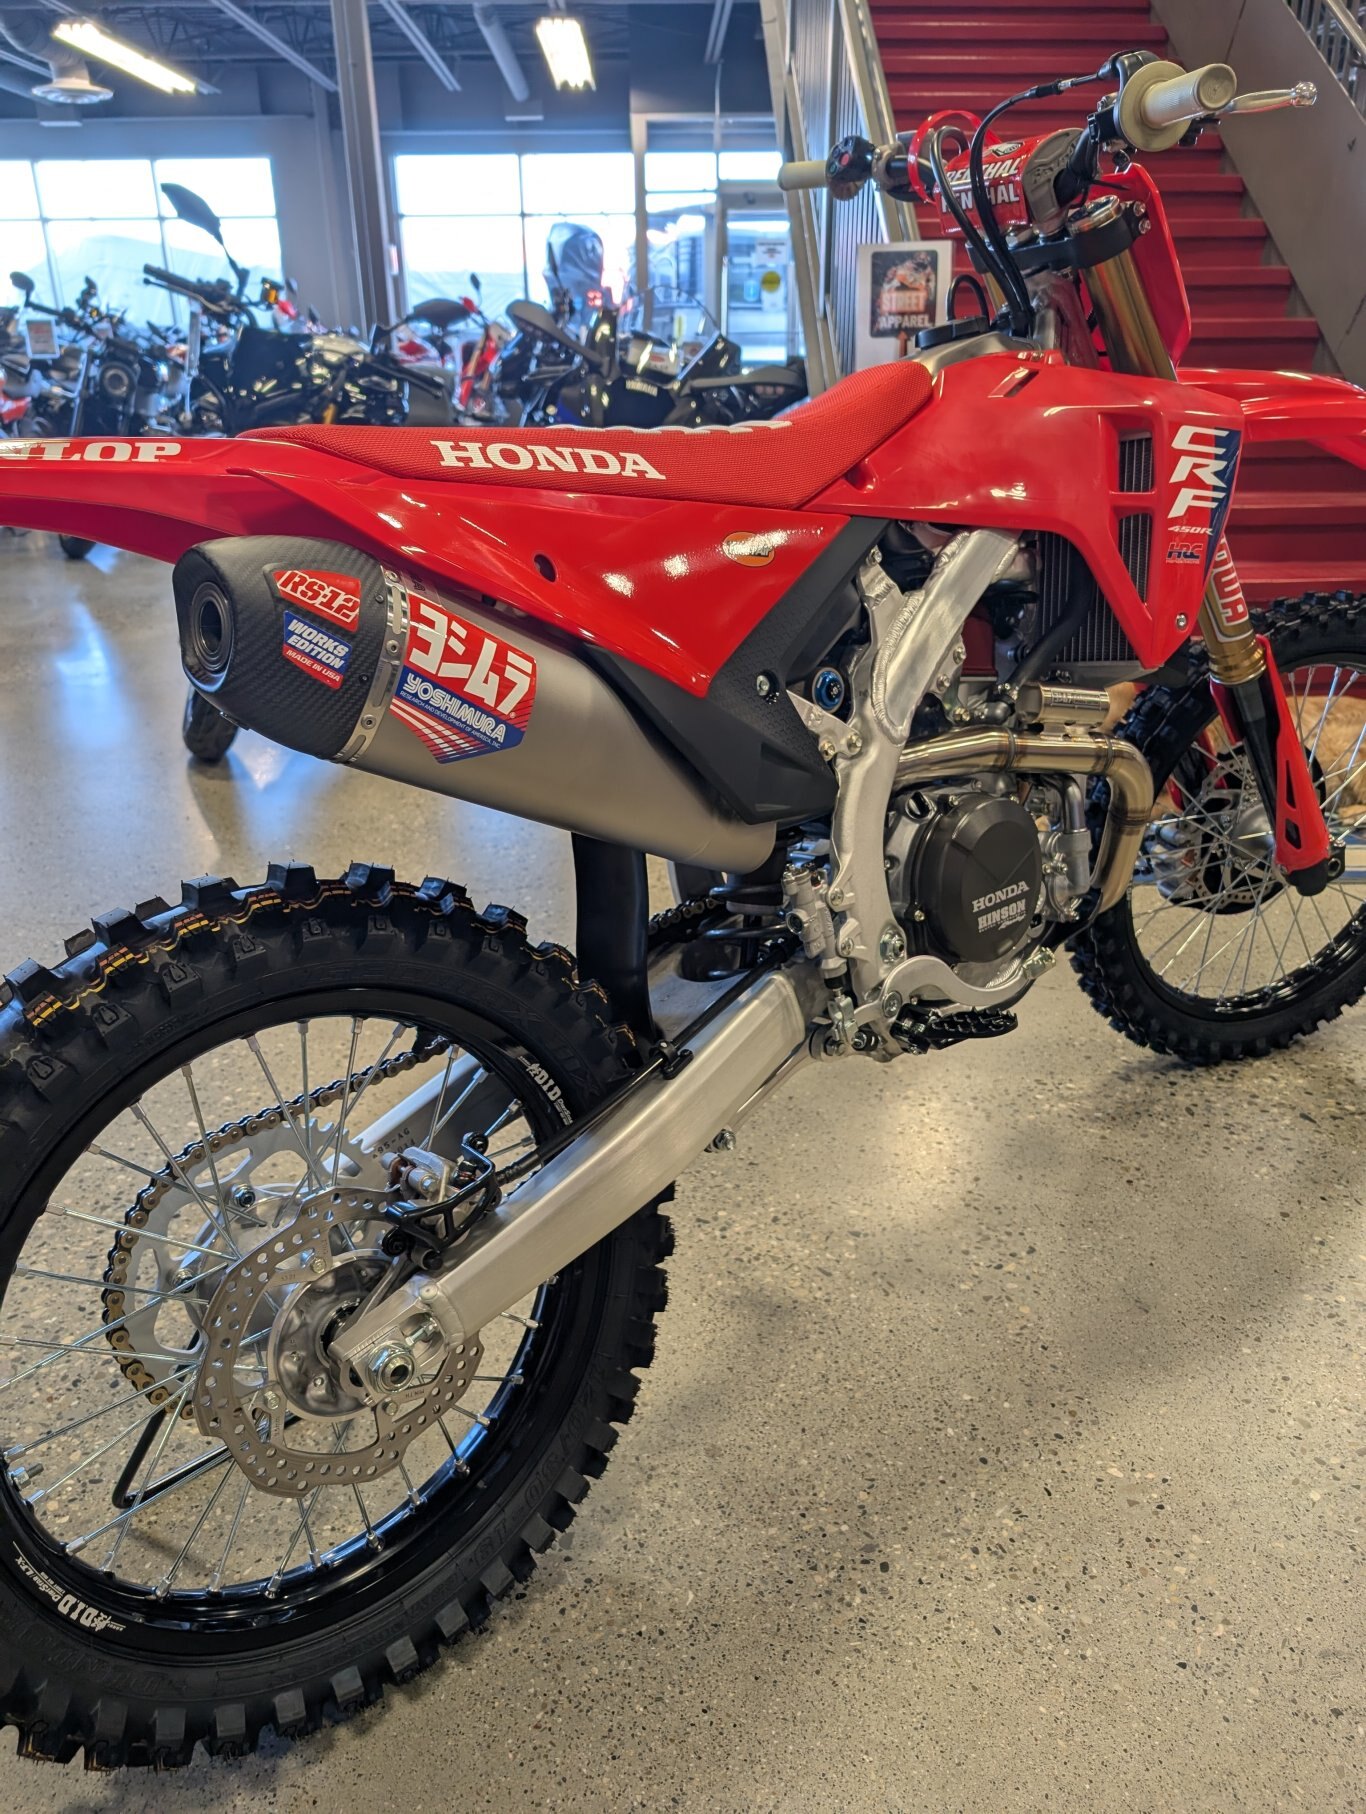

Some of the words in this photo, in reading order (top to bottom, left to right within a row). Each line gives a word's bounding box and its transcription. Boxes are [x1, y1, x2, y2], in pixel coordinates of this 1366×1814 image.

[882, 290, 927, 313] STREET
[874, 314, 930, 332] APPAREL
[430, 440, 666, 480] HONDA
[1167, 424, 1229, 518] CRF
[1168, 526, 1214, 536] 450R
[1167, 542, 1203, 559] HRC
[1213, 537, 1249, 626] OWA
[287, 635, 344, 668] EDITION
[288, 619, 348, 656] WORKS
[286, 650, 312, 668] MADE
[312, 662, 322, 672] IN
[322, 666, 340, 682] USA
[400, 692, 425, 706] RESEARCH
[434, 710, 466, 729] DEVELOPMENT
[402, 672, 506, 743] YOSHIMURA
[972, 881, 1030, 912] HONDA
[978, 899, 1026, 929] HINSON
